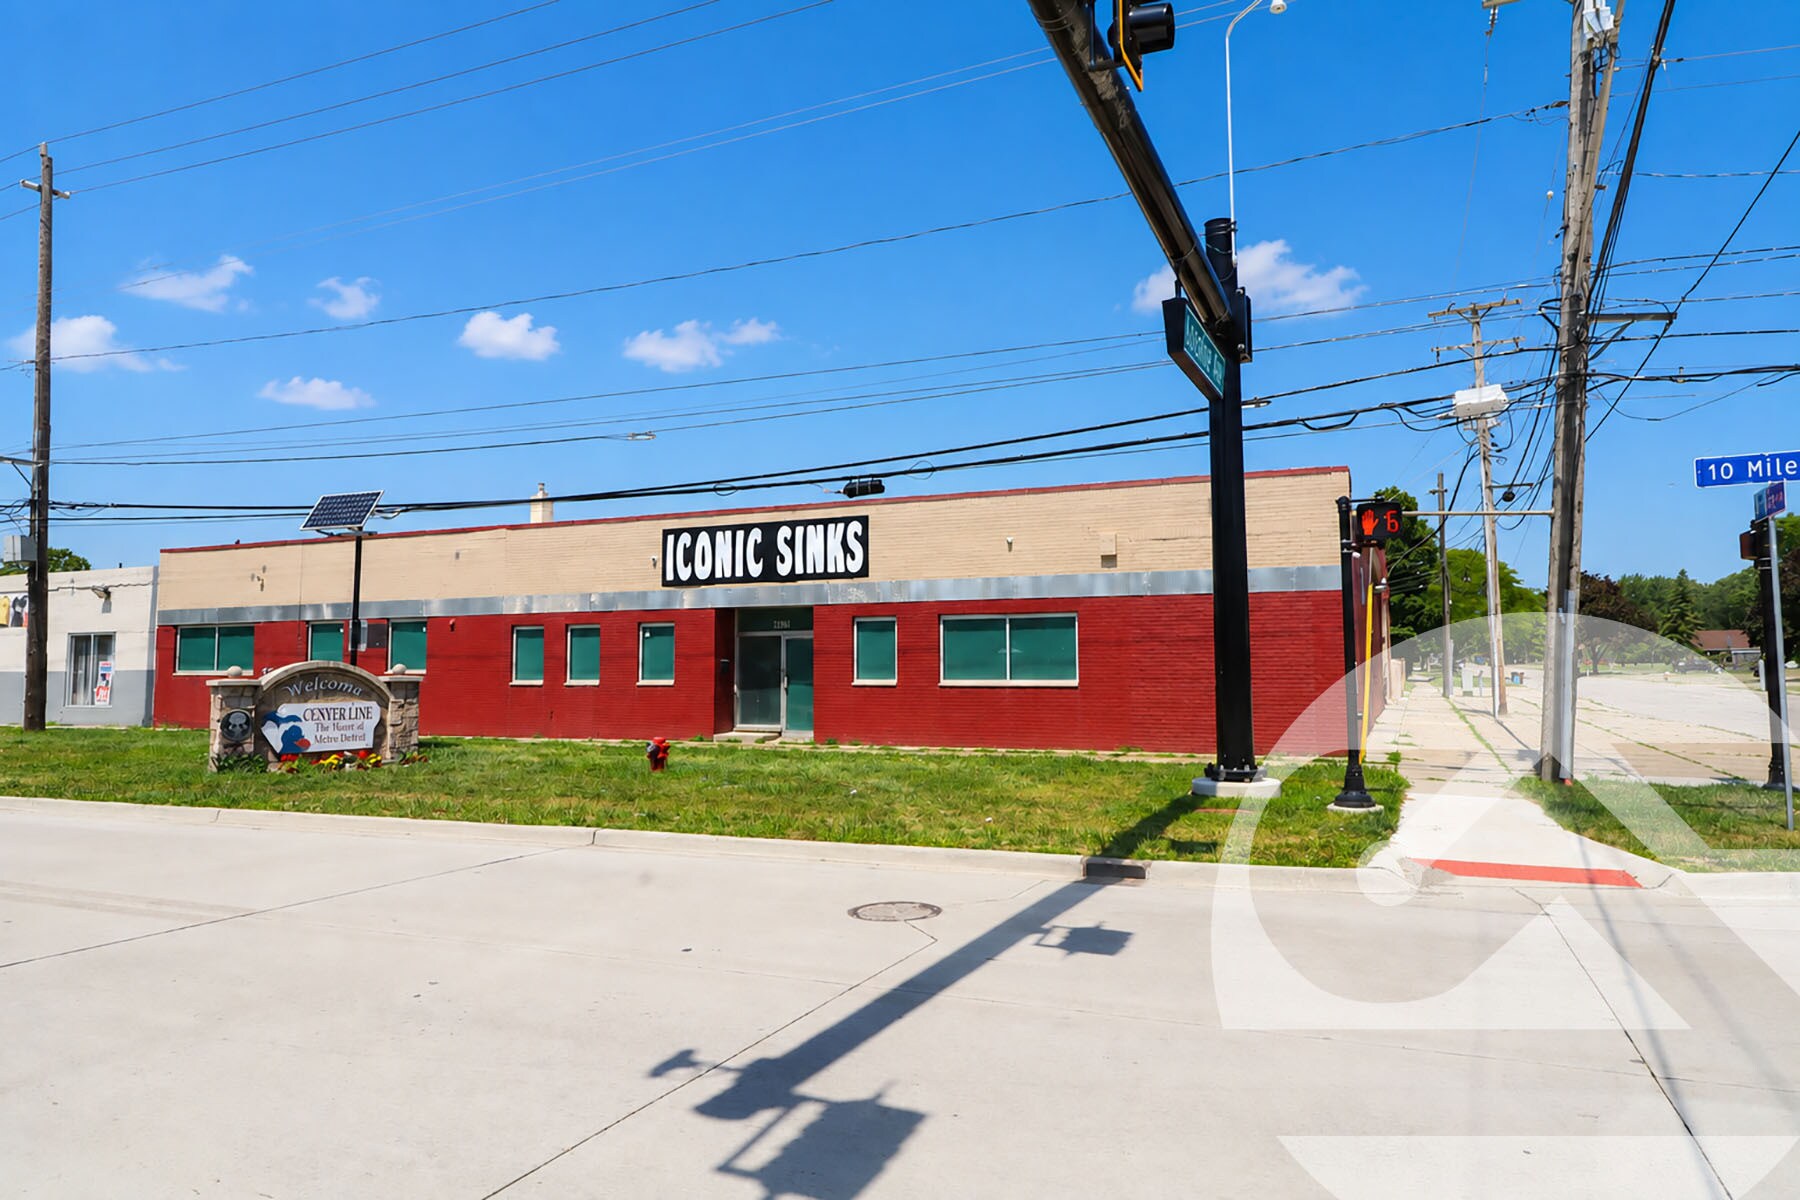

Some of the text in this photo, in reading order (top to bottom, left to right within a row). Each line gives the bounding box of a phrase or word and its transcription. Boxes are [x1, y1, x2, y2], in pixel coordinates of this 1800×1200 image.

[1708, 458, 1798, 480] 10 Mile
[1385, 509, 1400, 533] 6
[666, 520, 864, 582] ICONIC SINKS
[348, 705, 373, 720] LINE
